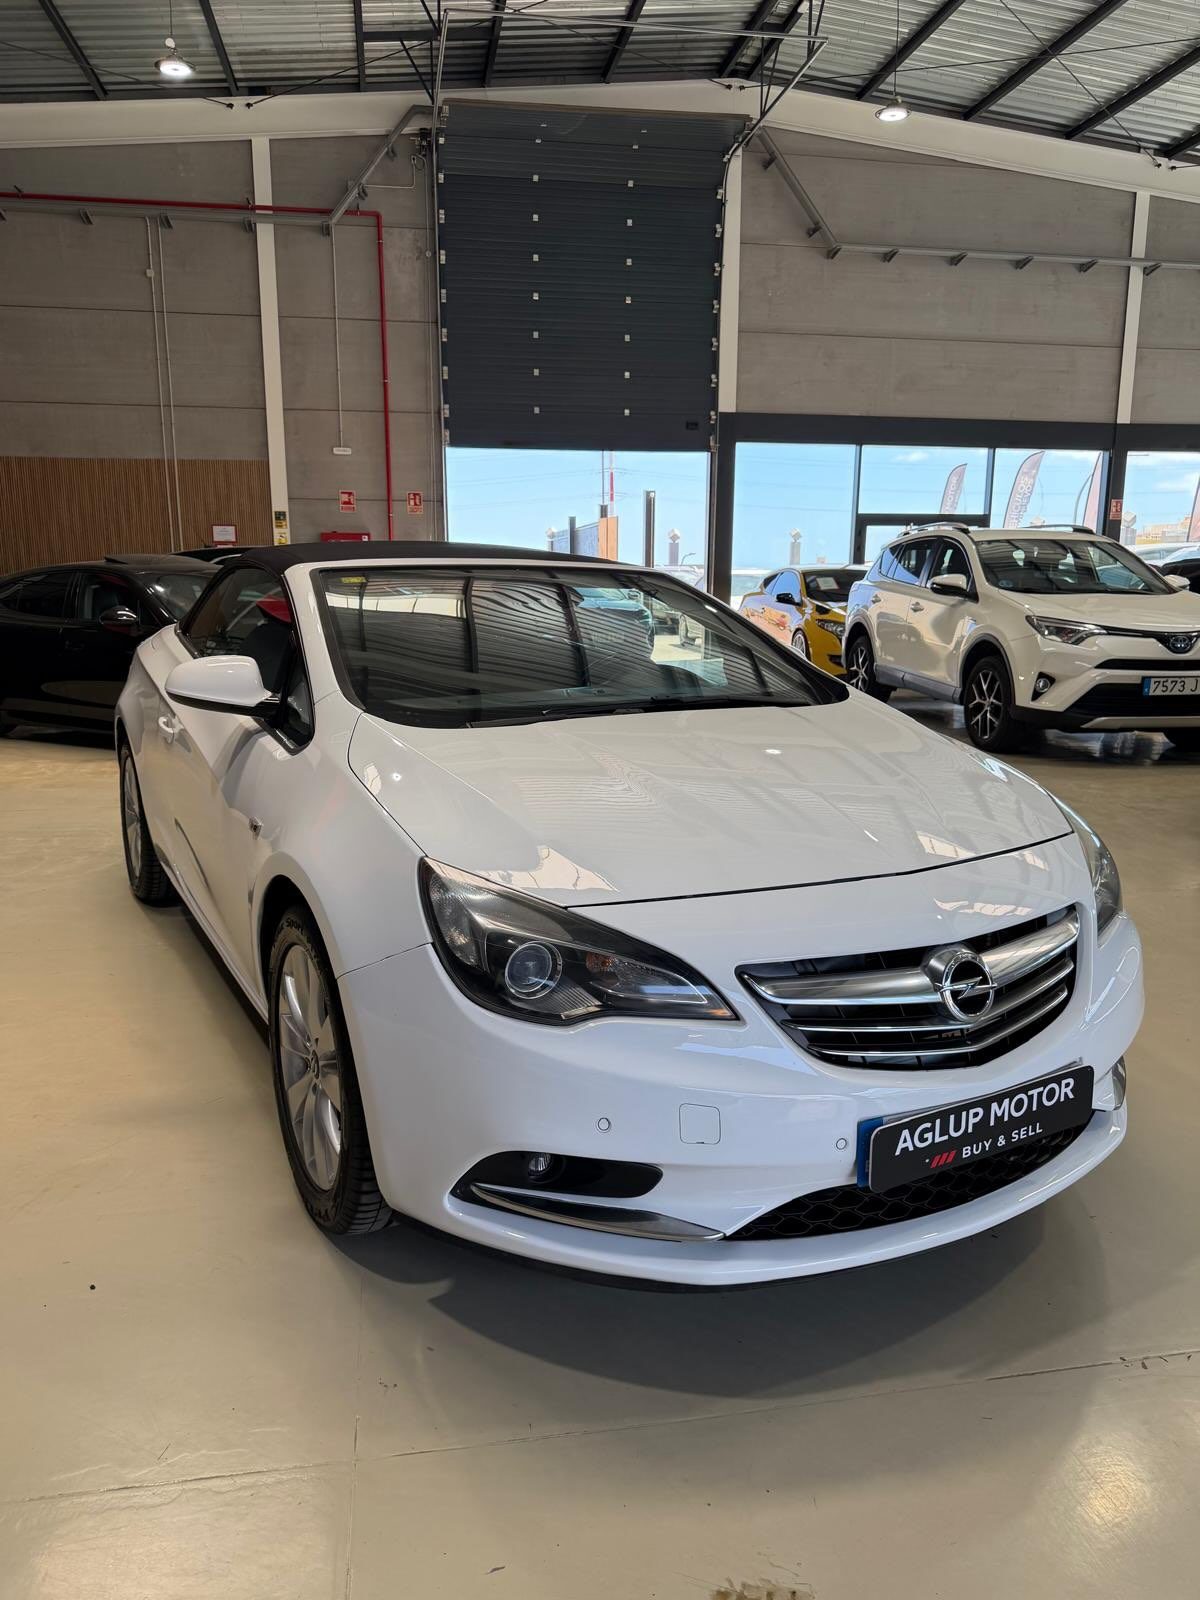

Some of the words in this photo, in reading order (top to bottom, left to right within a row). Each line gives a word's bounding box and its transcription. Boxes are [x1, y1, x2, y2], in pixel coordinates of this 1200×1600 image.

[1008, 475, 1028, 528] EHICULOS
[1153, 679, 1186, 693] 7573
[894, 1107, 984, 1156] AGLUP
[989, 1077, 1075, 1127] MOTOR
[962, 1140, 993, 1159] BUY
[997, 1134, 1006, 1147] &
[1011, 1122, 1043, 1143] SELL
